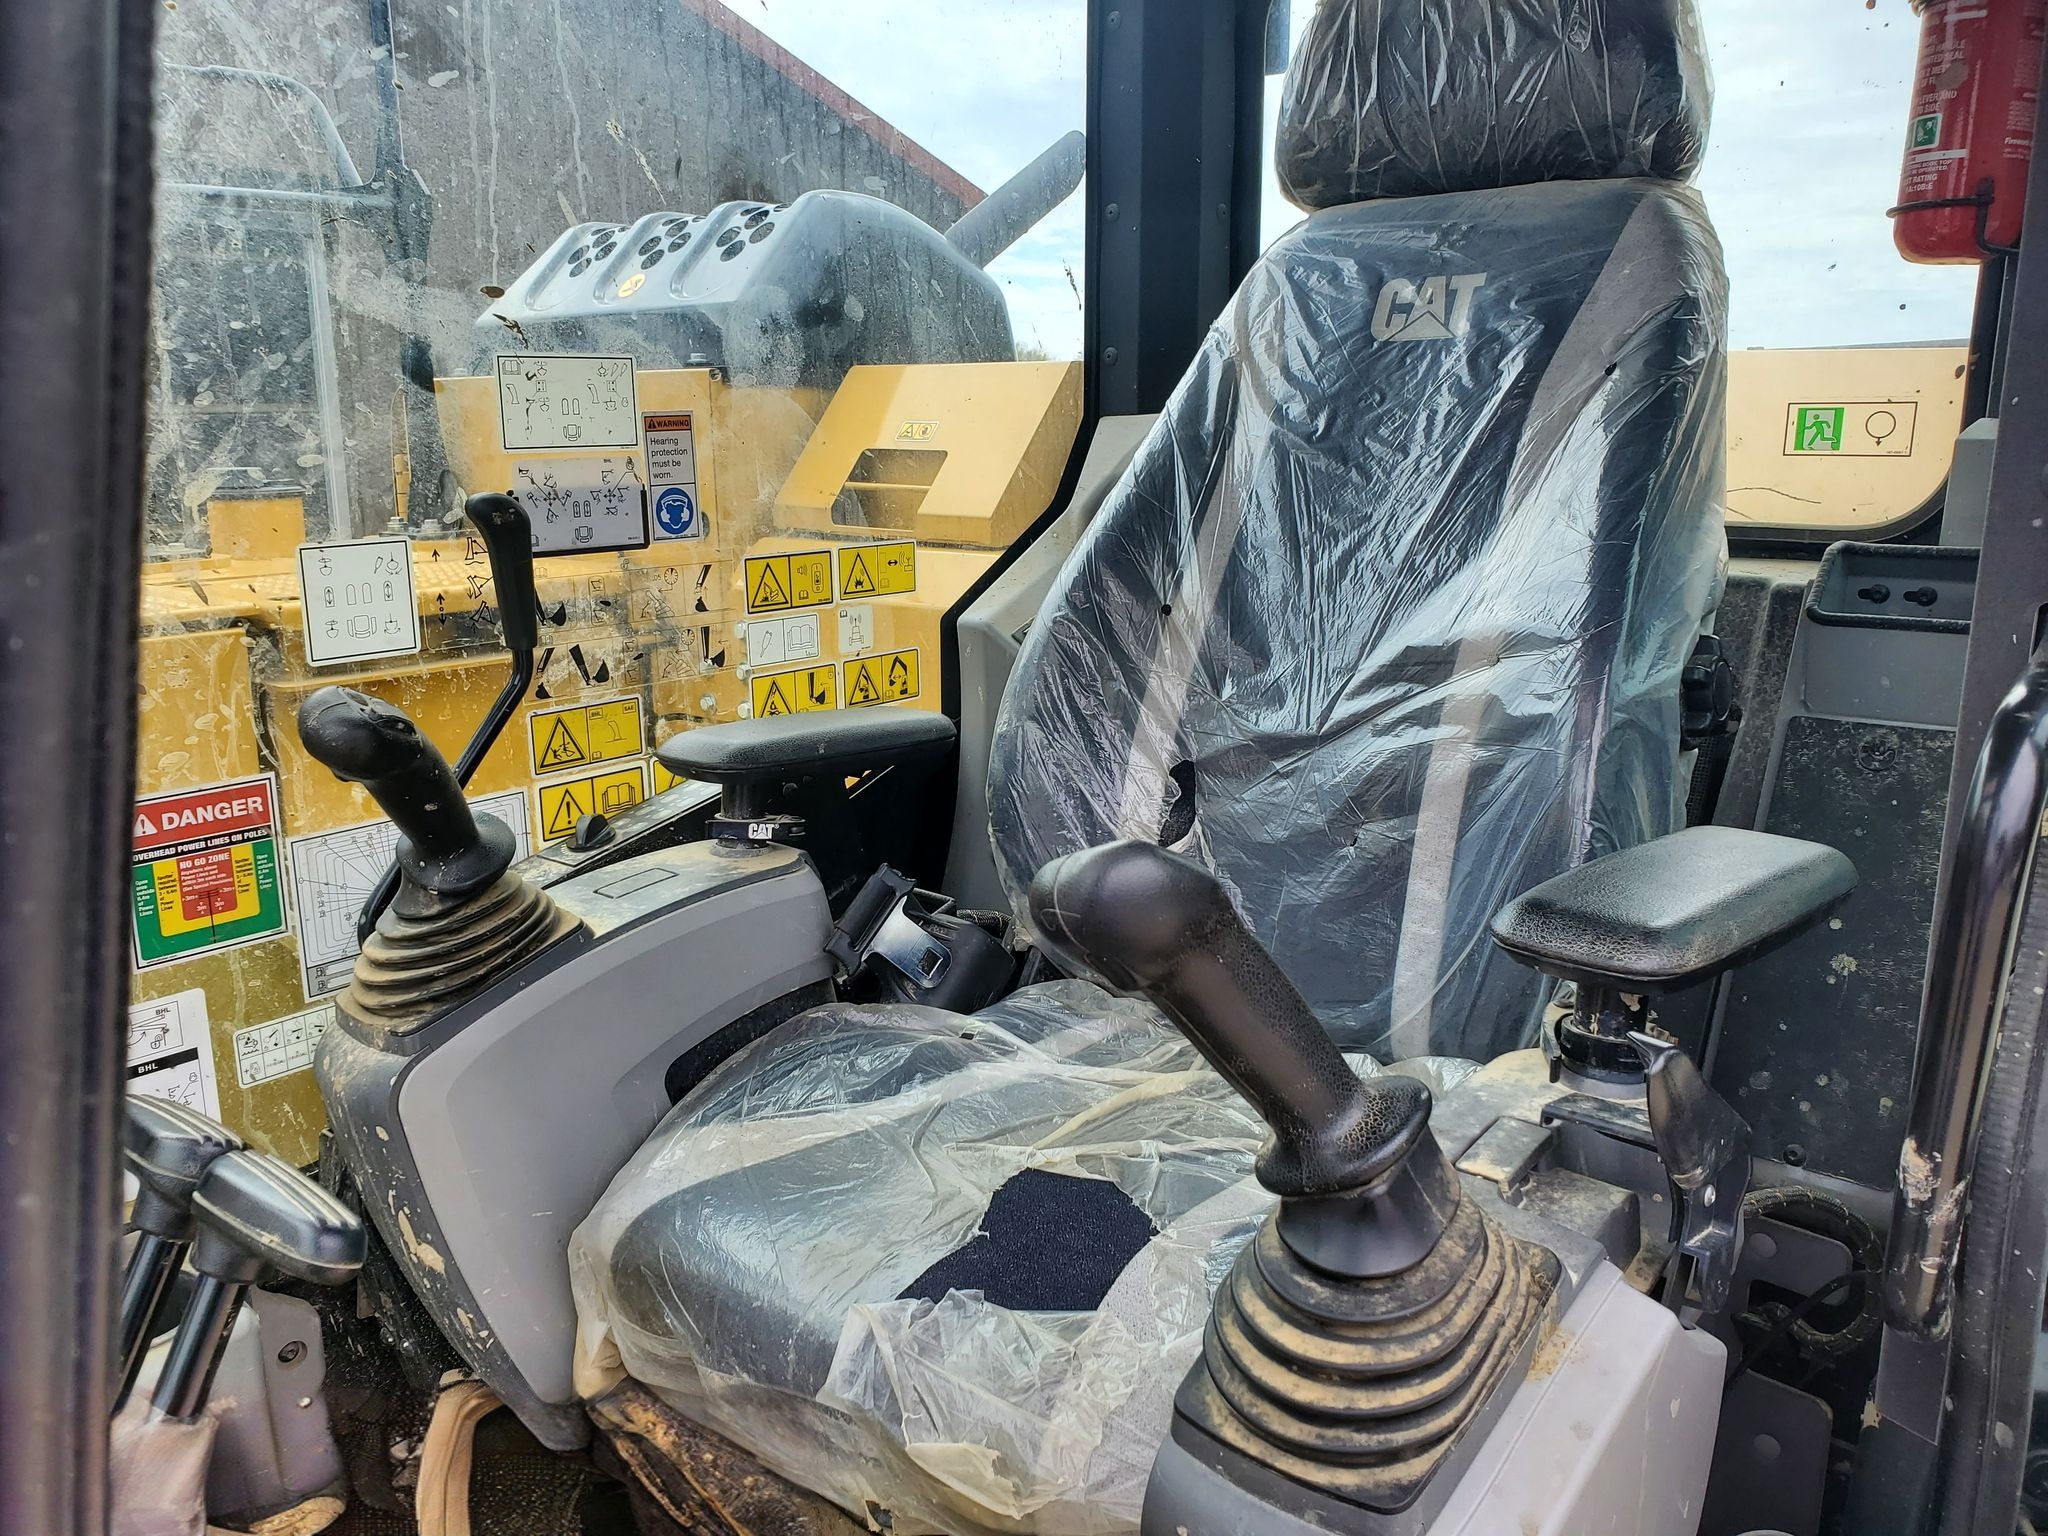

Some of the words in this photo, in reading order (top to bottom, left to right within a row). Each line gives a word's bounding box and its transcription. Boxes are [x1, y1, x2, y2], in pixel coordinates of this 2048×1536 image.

[1371, 272, 1487, 341] CAT
[657, 420, 689, 428] WARNING
[650, 437, 679, 446] Hearing
[651, 448, 688, 458] protection
[652, 460, 670, 468] must
[672, 459, 681, 467] be
[161, 796, 264, 831] DANGER
[748, 823, 775, 840] CAT
[133, 847, 175, 861] OVERHEAD
[177, 841, 206, 853] POWER
[207, 835, 230, 847] LINES
[231, 833, 242, 841] ON
[244, 829, 268, 840] POLES
[180, 860, 192, 869] NO
[194, 857, 206, 866] GO
[208, 852, 230, 863] ZONE
[155, 1008, 171, 1016] BHL
[138, 1062, 158, 1074] BHL
